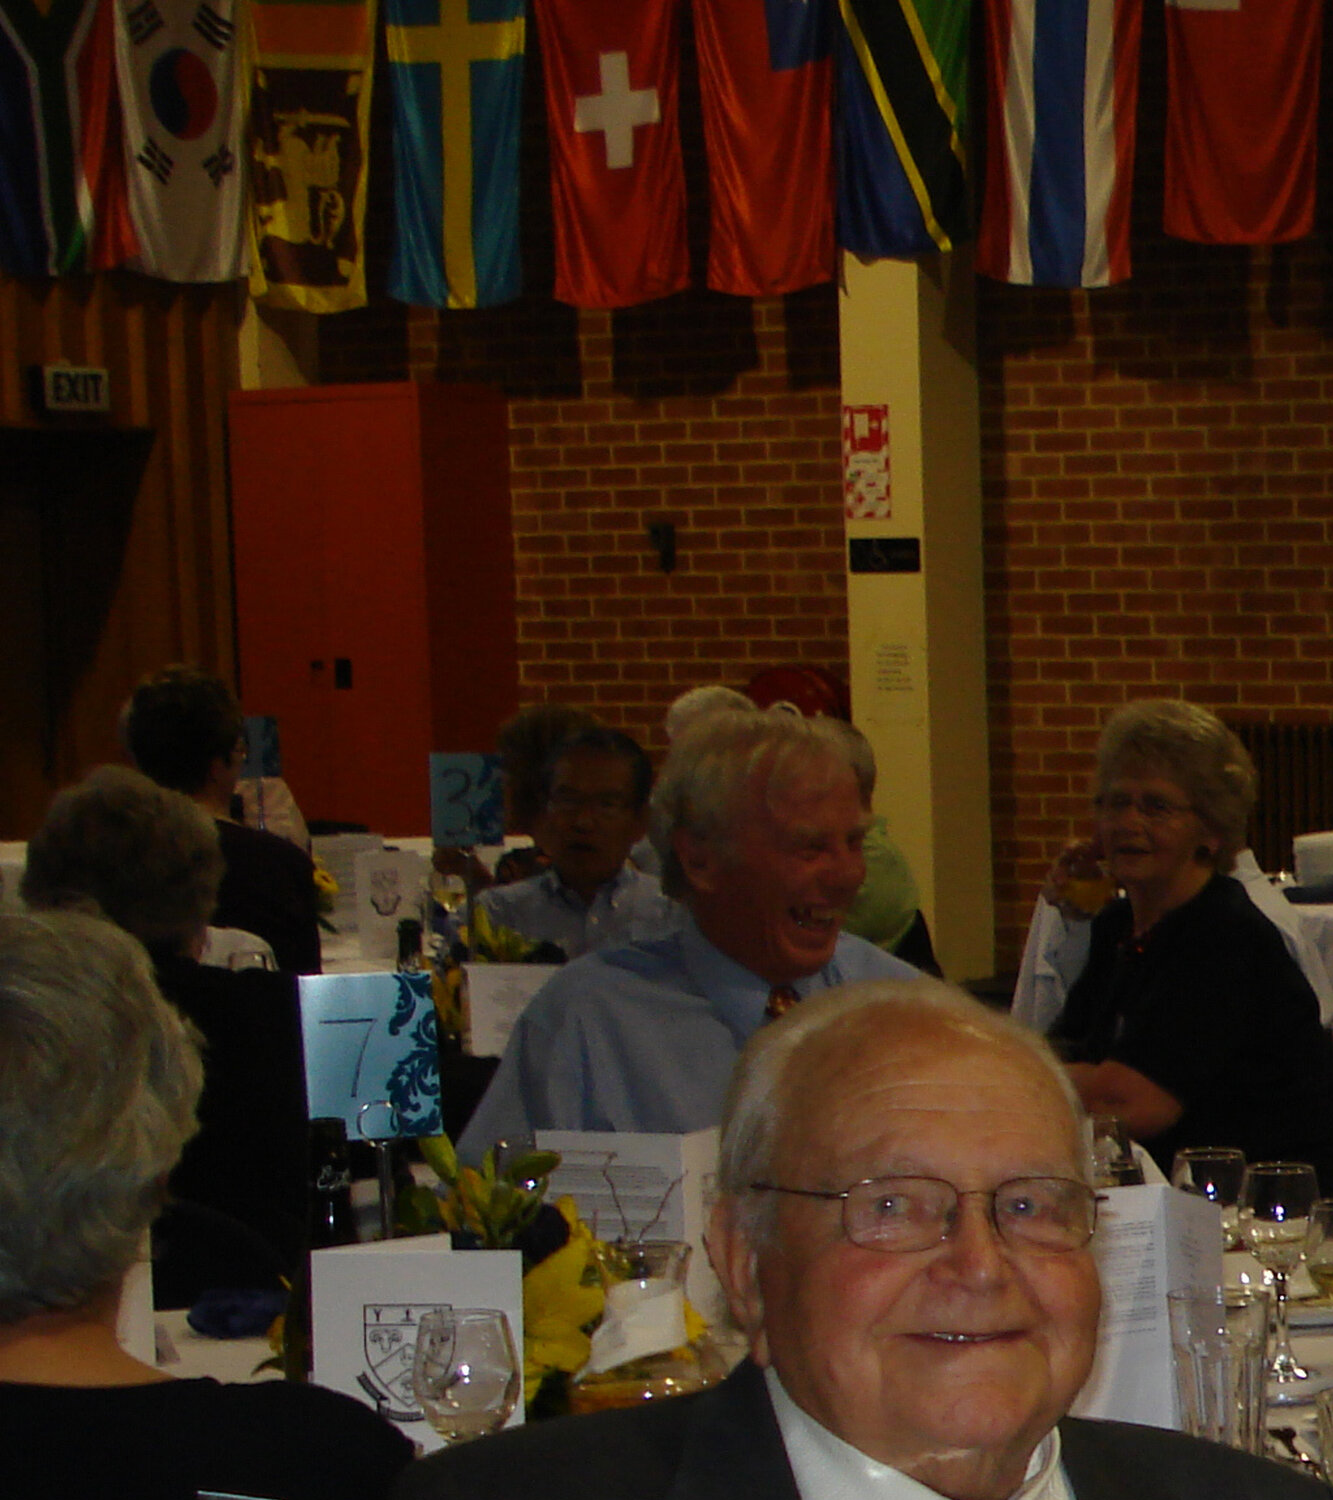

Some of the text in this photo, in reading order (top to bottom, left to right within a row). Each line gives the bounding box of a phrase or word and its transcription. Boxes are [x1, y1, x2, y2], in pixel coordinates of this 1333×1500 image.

[53, 371, 103, 404] EXIT
[441, 767, 474, 836] 3
[319, 1017, 378, 1099] 7
